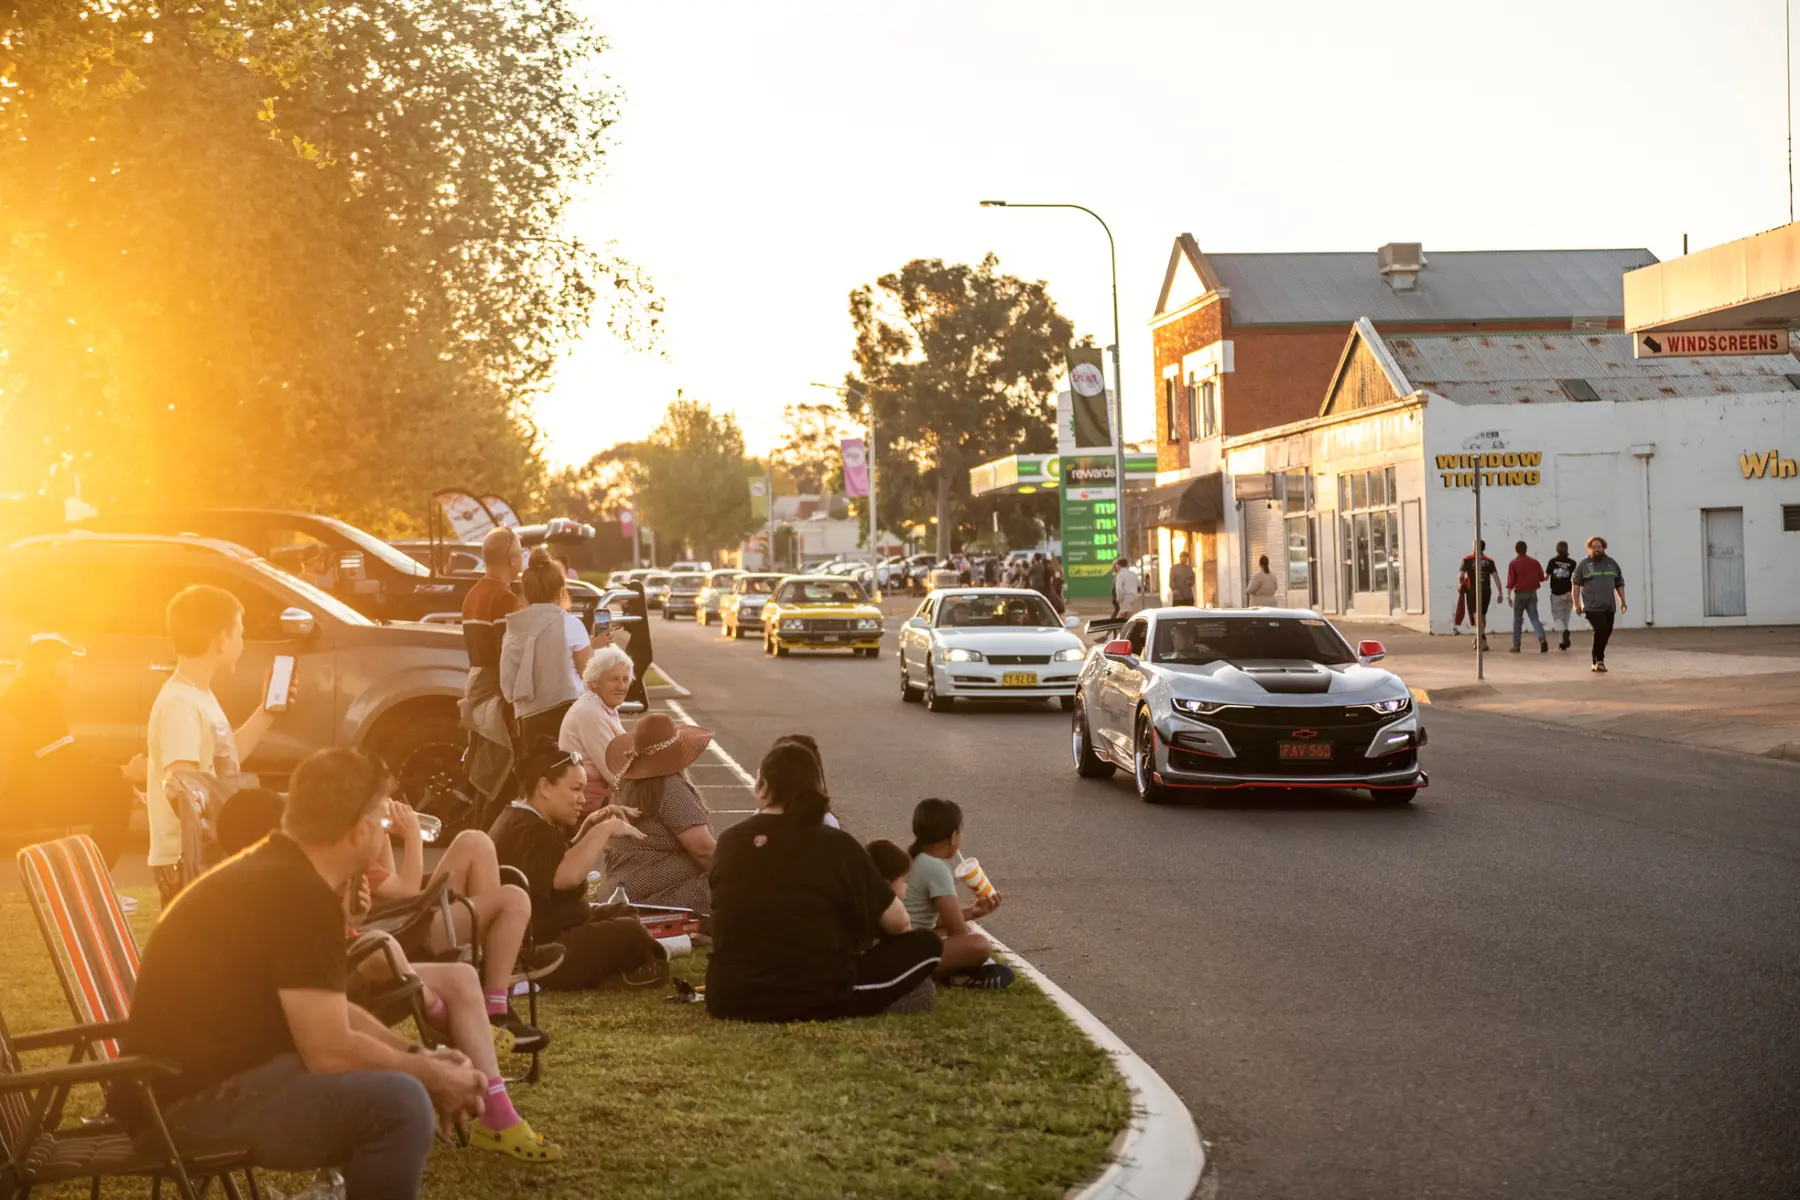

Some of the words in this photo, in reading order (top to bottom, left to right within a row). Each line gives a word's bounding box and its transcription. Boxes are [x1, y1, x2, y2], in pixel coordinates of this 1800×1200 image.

[1667, 334, 1778, 352] WINDSCREENS
[1435, 452, 1542, 469] WINDOW
[1739, 449, 1800, 479] Win
[1072, 466, 1116, 479] rewards
